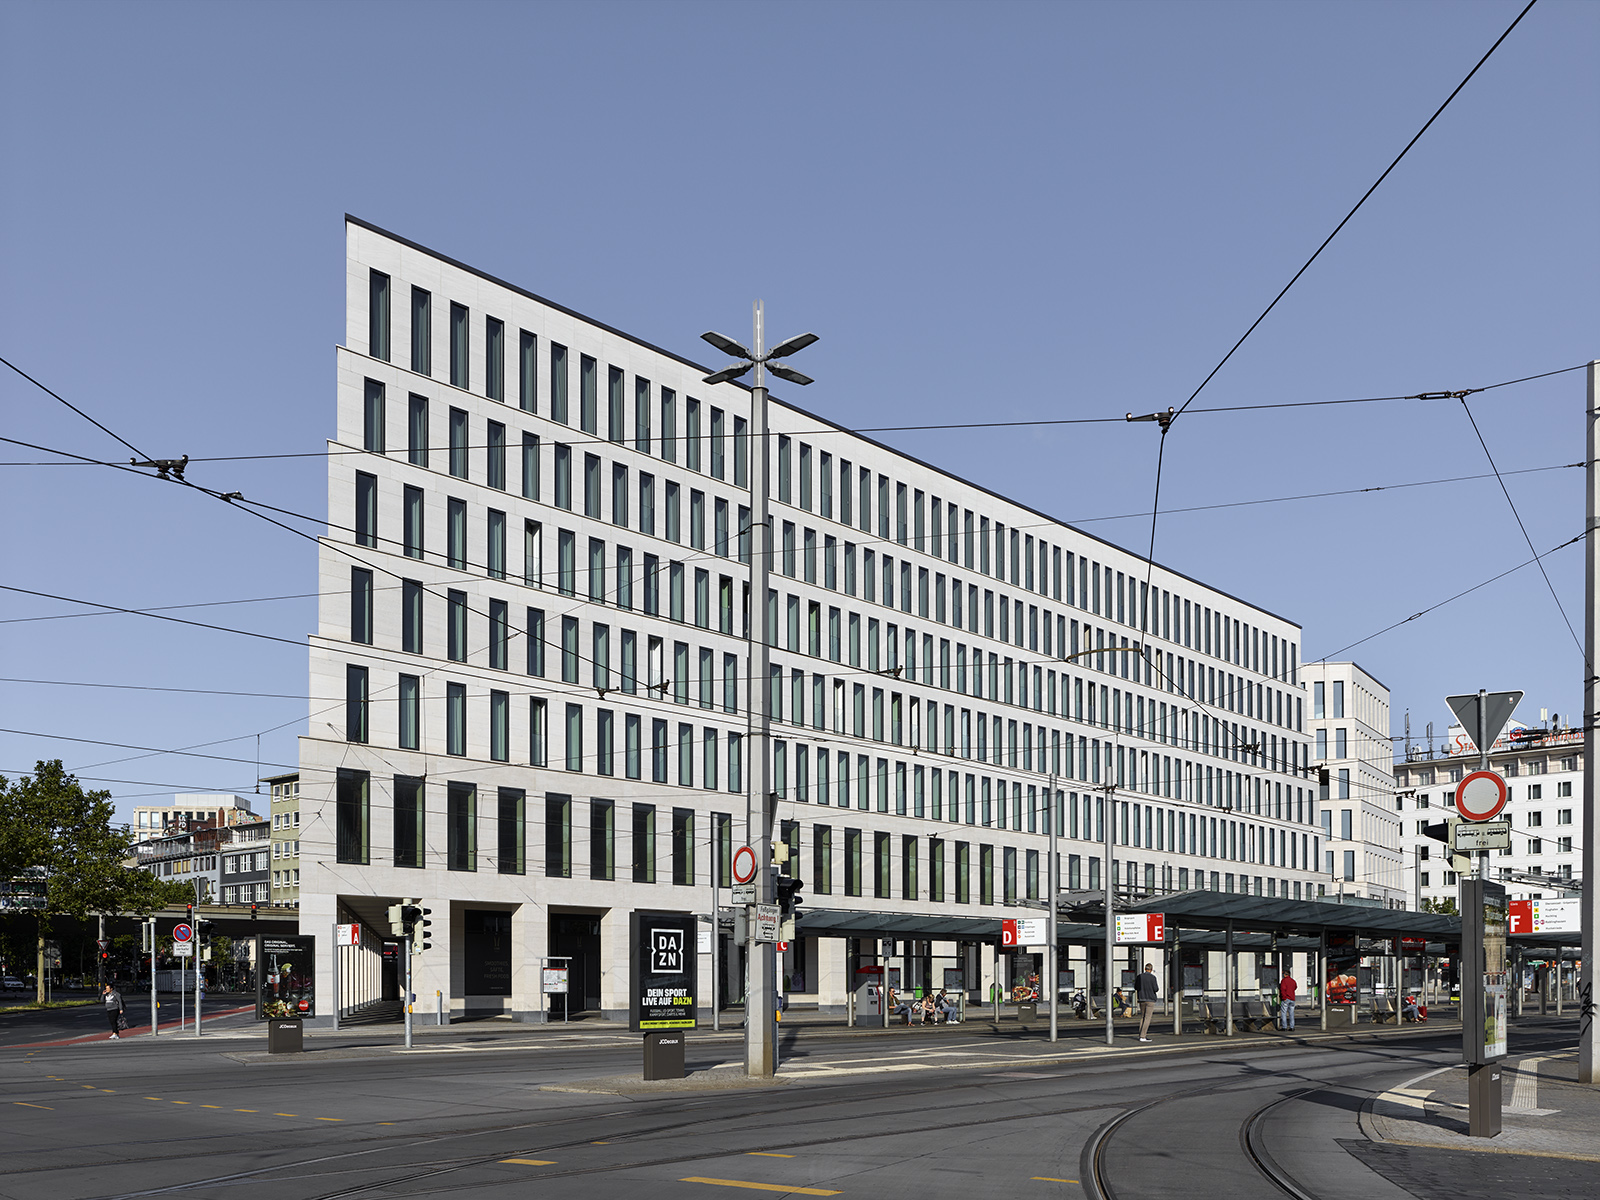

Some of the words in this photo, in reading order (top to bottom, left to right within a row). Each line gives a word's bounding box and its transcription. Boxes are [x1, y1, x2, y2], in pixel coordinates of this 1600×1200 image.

[1510, 915, 1521, 933] F
[353, 932, 359, 944] A
[1003, 930, 1012, 945] D
[1154, 925, 1163, 940] E
[647, 988, 664, 997] DEIN
[664, 988, 687, 997] SPORT
[642, 997, 658, 1006] LIVE
[658, 997, 672, 1006] AUF
[673, 996, 692, 1005] DAZN
